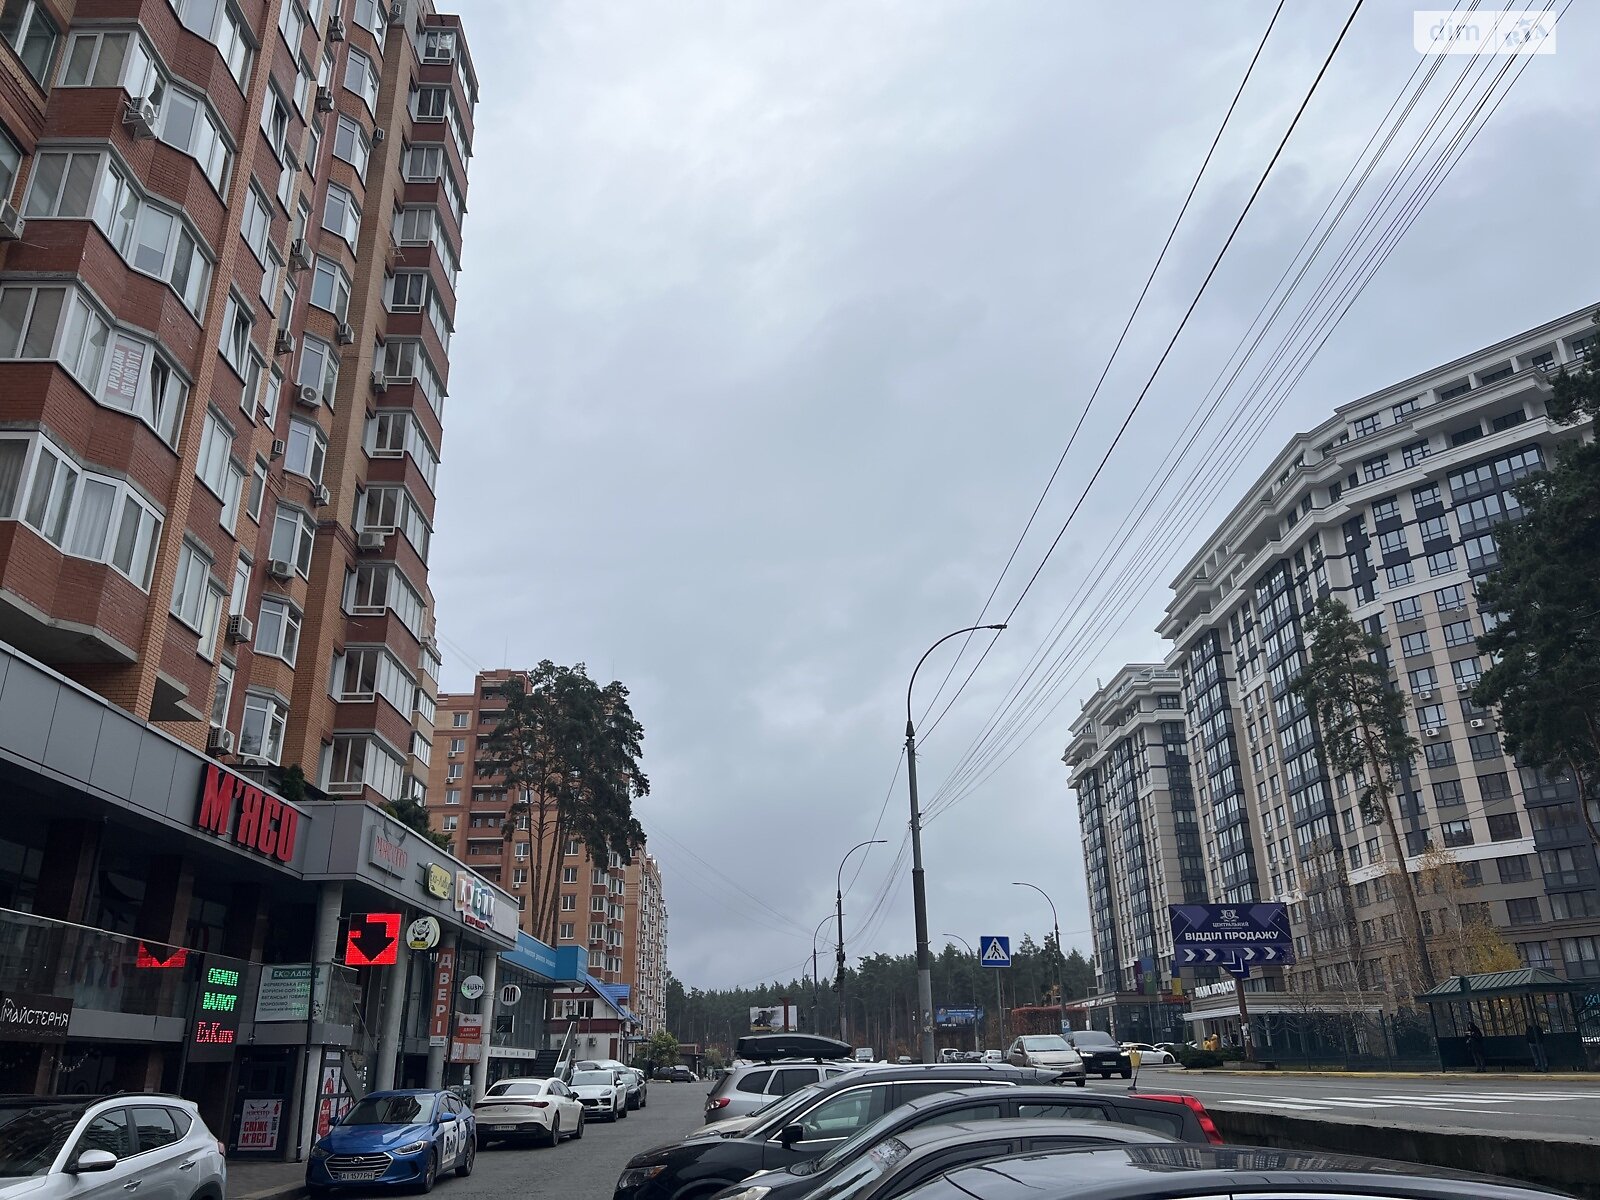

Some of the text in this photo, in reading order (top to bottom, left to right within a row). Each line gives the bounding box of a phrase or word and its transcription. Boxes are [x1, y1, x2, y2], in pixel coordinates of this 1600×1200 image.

[199, 763, 299, 862] М'ЯСО
[1185, 931, 1279, 941] ВІДДІЛ ПРОДАЖУ
[207, 967, 239, 987] ОБМІН
[273, 970, 319, 978] ЕКОЛАВК
[202, 992, 238, 1012] ВАЛЮТ
[436, 954, 452, 1033] ДВЕРІ
